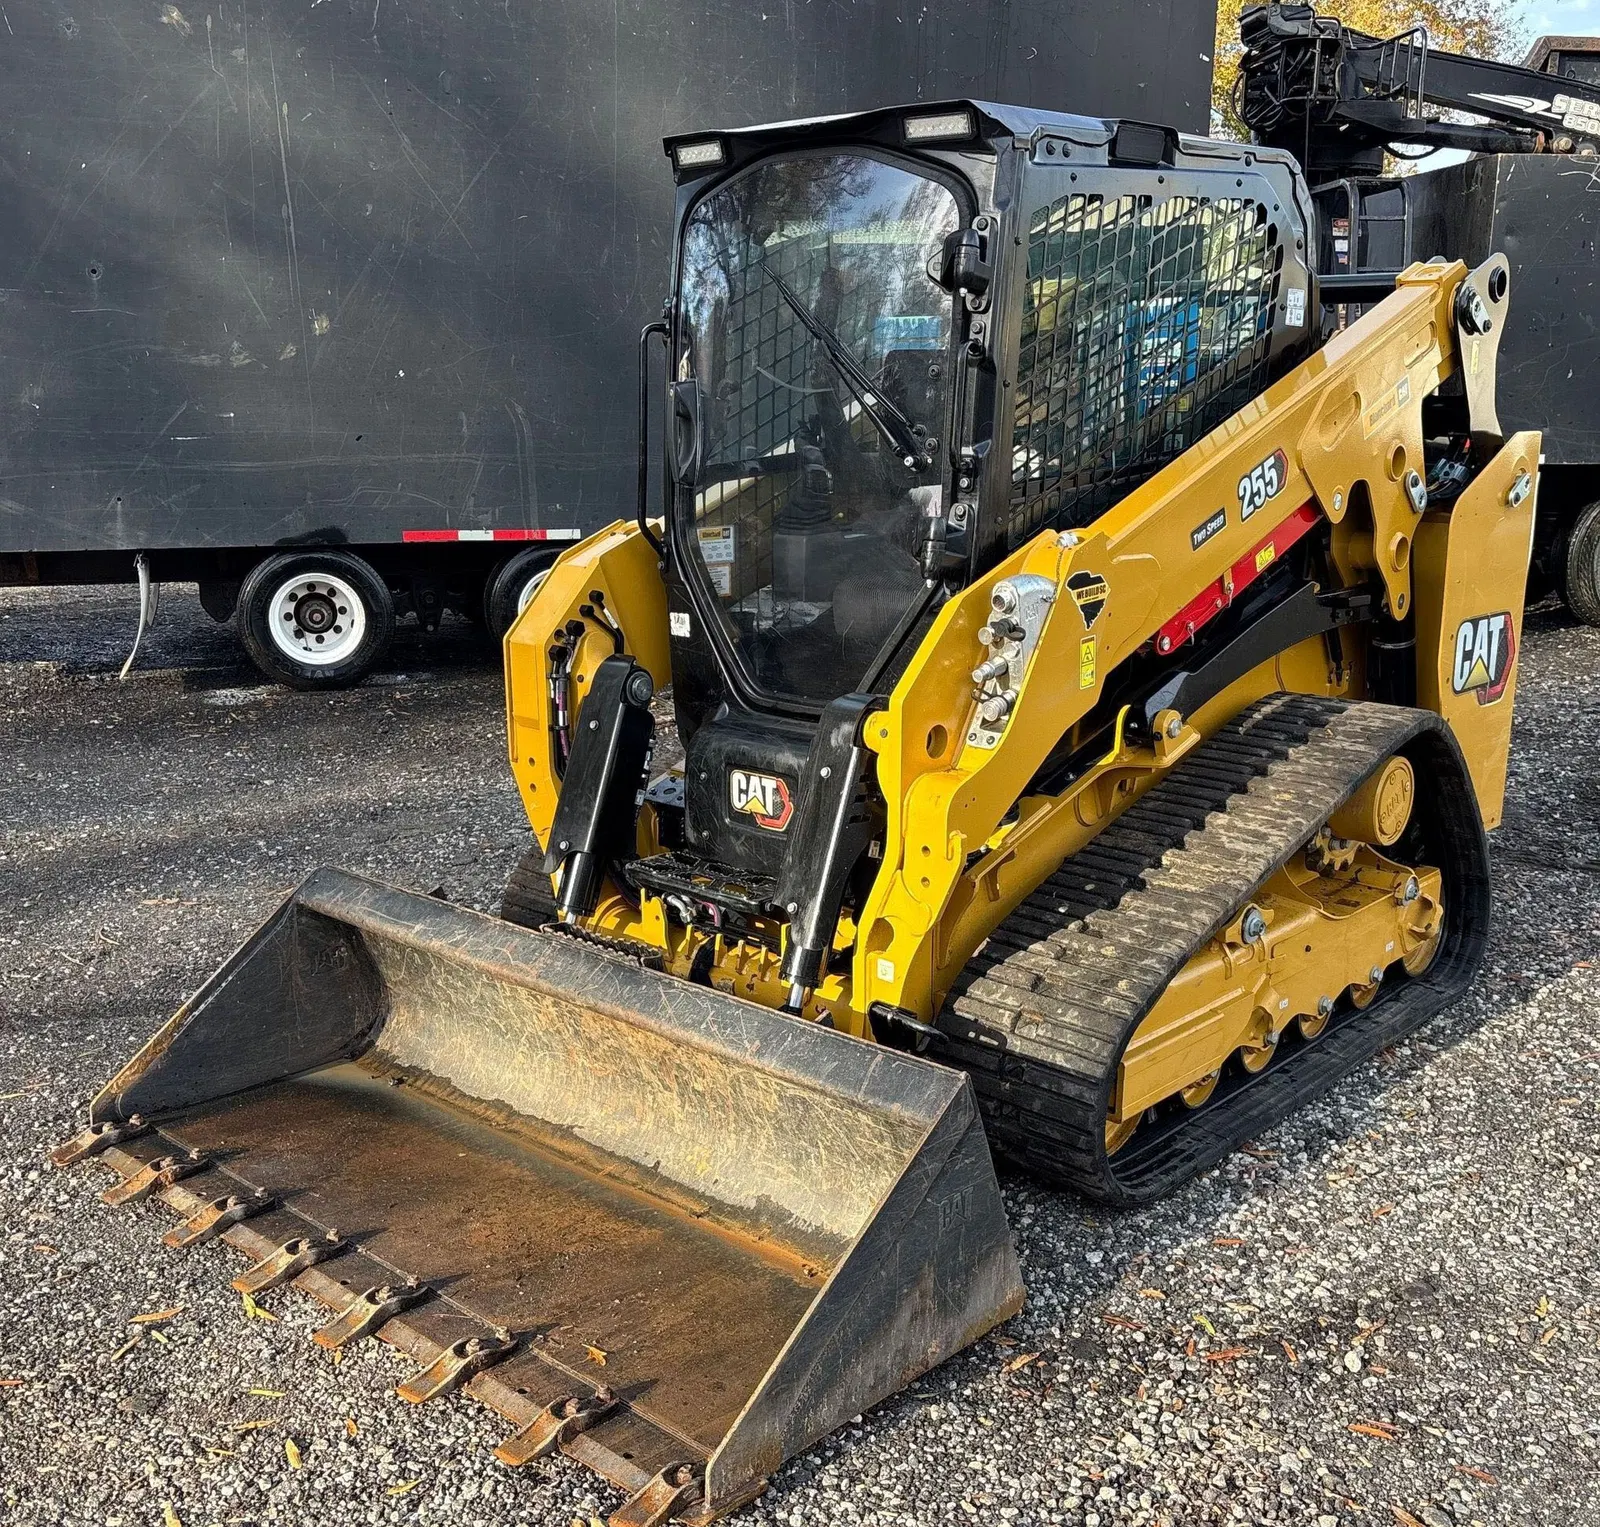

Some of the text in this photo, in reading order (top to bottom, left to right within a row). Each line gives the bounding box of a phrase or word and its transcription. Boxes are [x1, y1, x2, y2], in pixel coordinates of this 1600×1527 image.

[1552, 94, 1600, 120] SER
[1563, 113, 1600, 135] 850
[1239, 455, 1278, 519] 255
[1076, 590, 1085, 600] WE
[1085, 586, 1099, 598] BUILD
[1099, 584, 1107, 595] SC
[1453, 615, 1505, 691] CAT
[732, 772, 777, 816] CAT
